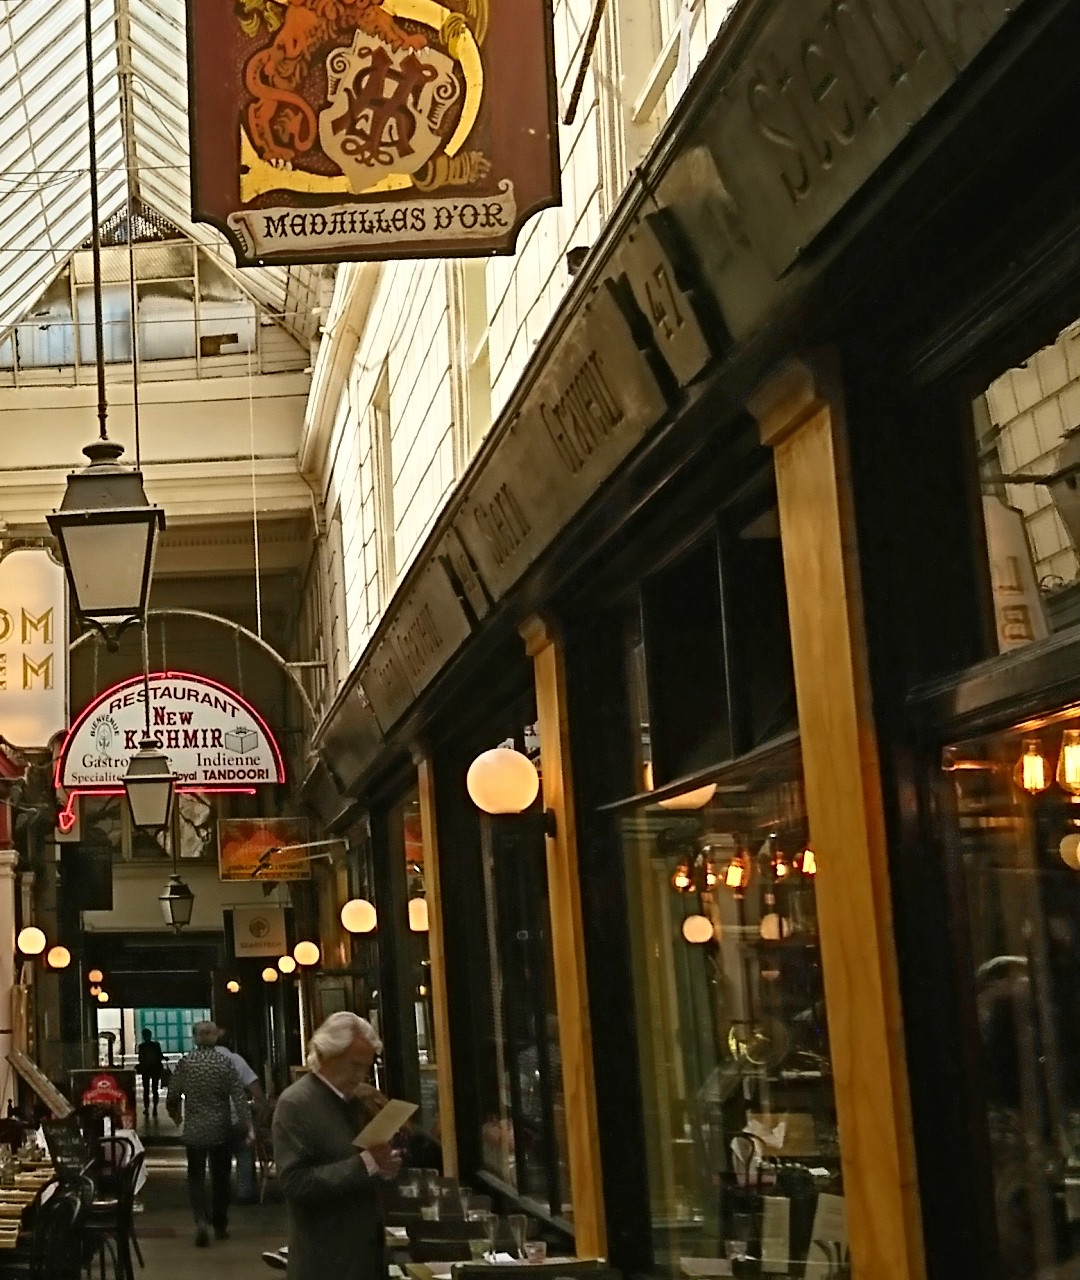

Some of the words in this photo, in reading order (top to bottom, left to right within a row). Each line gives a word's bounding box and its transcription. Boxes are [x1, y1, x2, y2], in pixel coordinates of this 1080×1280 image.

[643, 262, 686, 341] 47
[472, 482, 533, 569] Stern
[538, 349, 626, 474] Graveur
[109, 686, 240, 718] RESTAURANT
[90, 714, 120, 737] BIENVENUE
[197, 753, 261, 767] Indienne
[203, 769, 269, 781] TANDOORI
